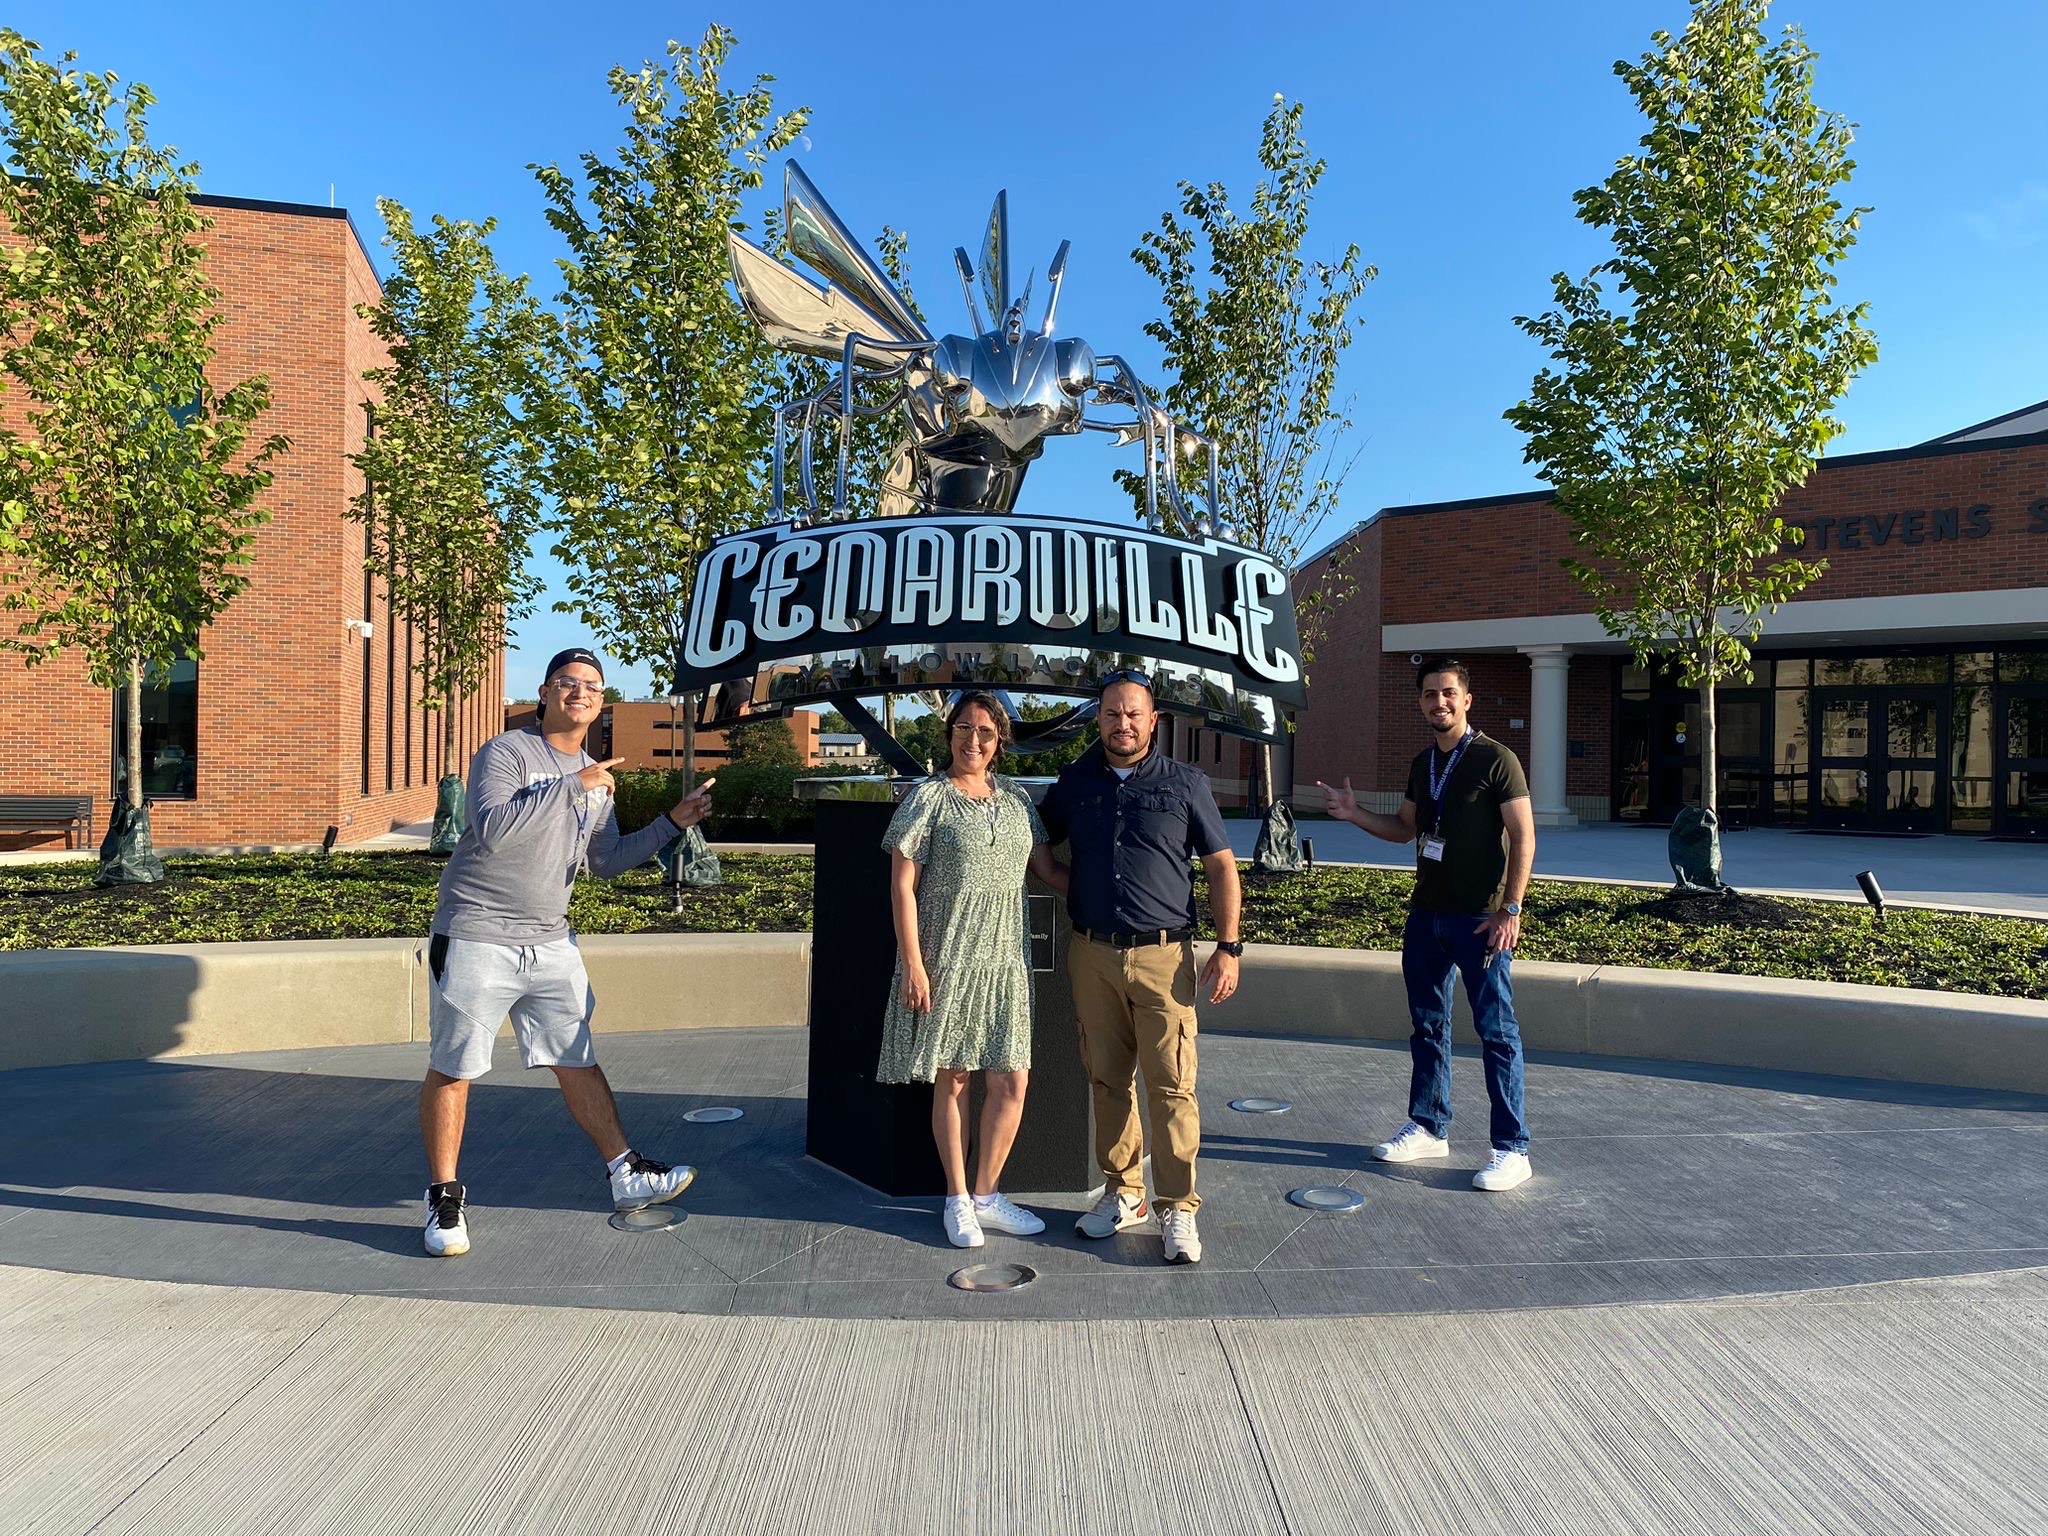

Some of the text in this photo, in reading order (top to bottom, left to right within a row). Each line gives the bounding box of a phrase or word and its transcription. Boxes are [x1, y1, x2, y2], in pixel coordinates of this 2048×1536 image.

[1780, 503, 1993, 553] STEVENS
[684, 524, 1300, 684] CEDARVILLE
[800, 652, 982, 679] YELLOW
